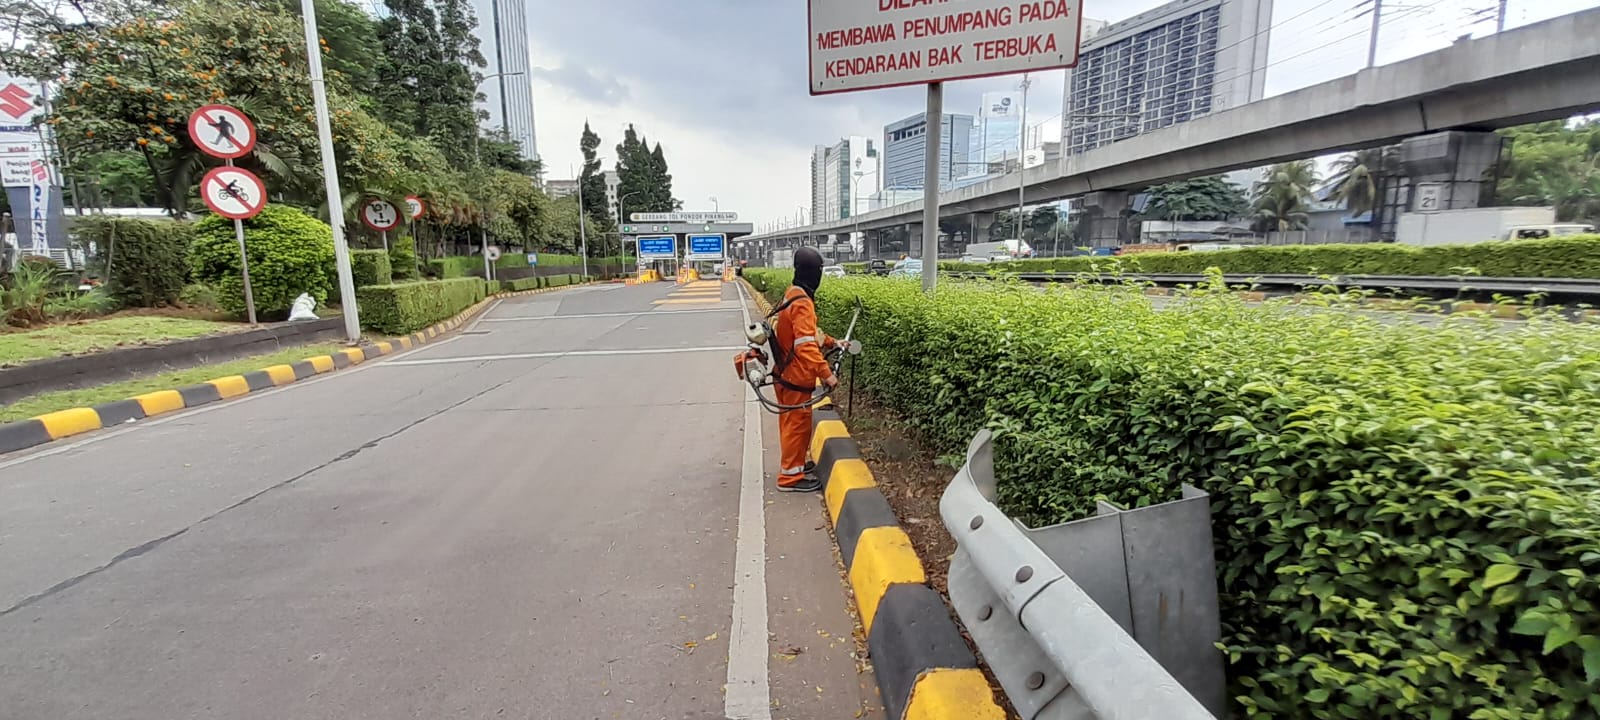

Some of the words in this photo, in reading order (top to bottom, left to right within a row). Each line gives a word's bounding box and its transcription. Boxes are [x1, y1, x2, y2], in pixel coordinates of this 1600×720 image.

[818, 24, 896, 50] MEMBAWA
[903, 7, 1012, 39] PENUMPANG
[1018, 0, 1069, 24] PADA
[825, 51, 921, 79] KENDARAAN
[928, 44, 963, 67] BAK
[973, 33, 1057, 61] TERBUKA
